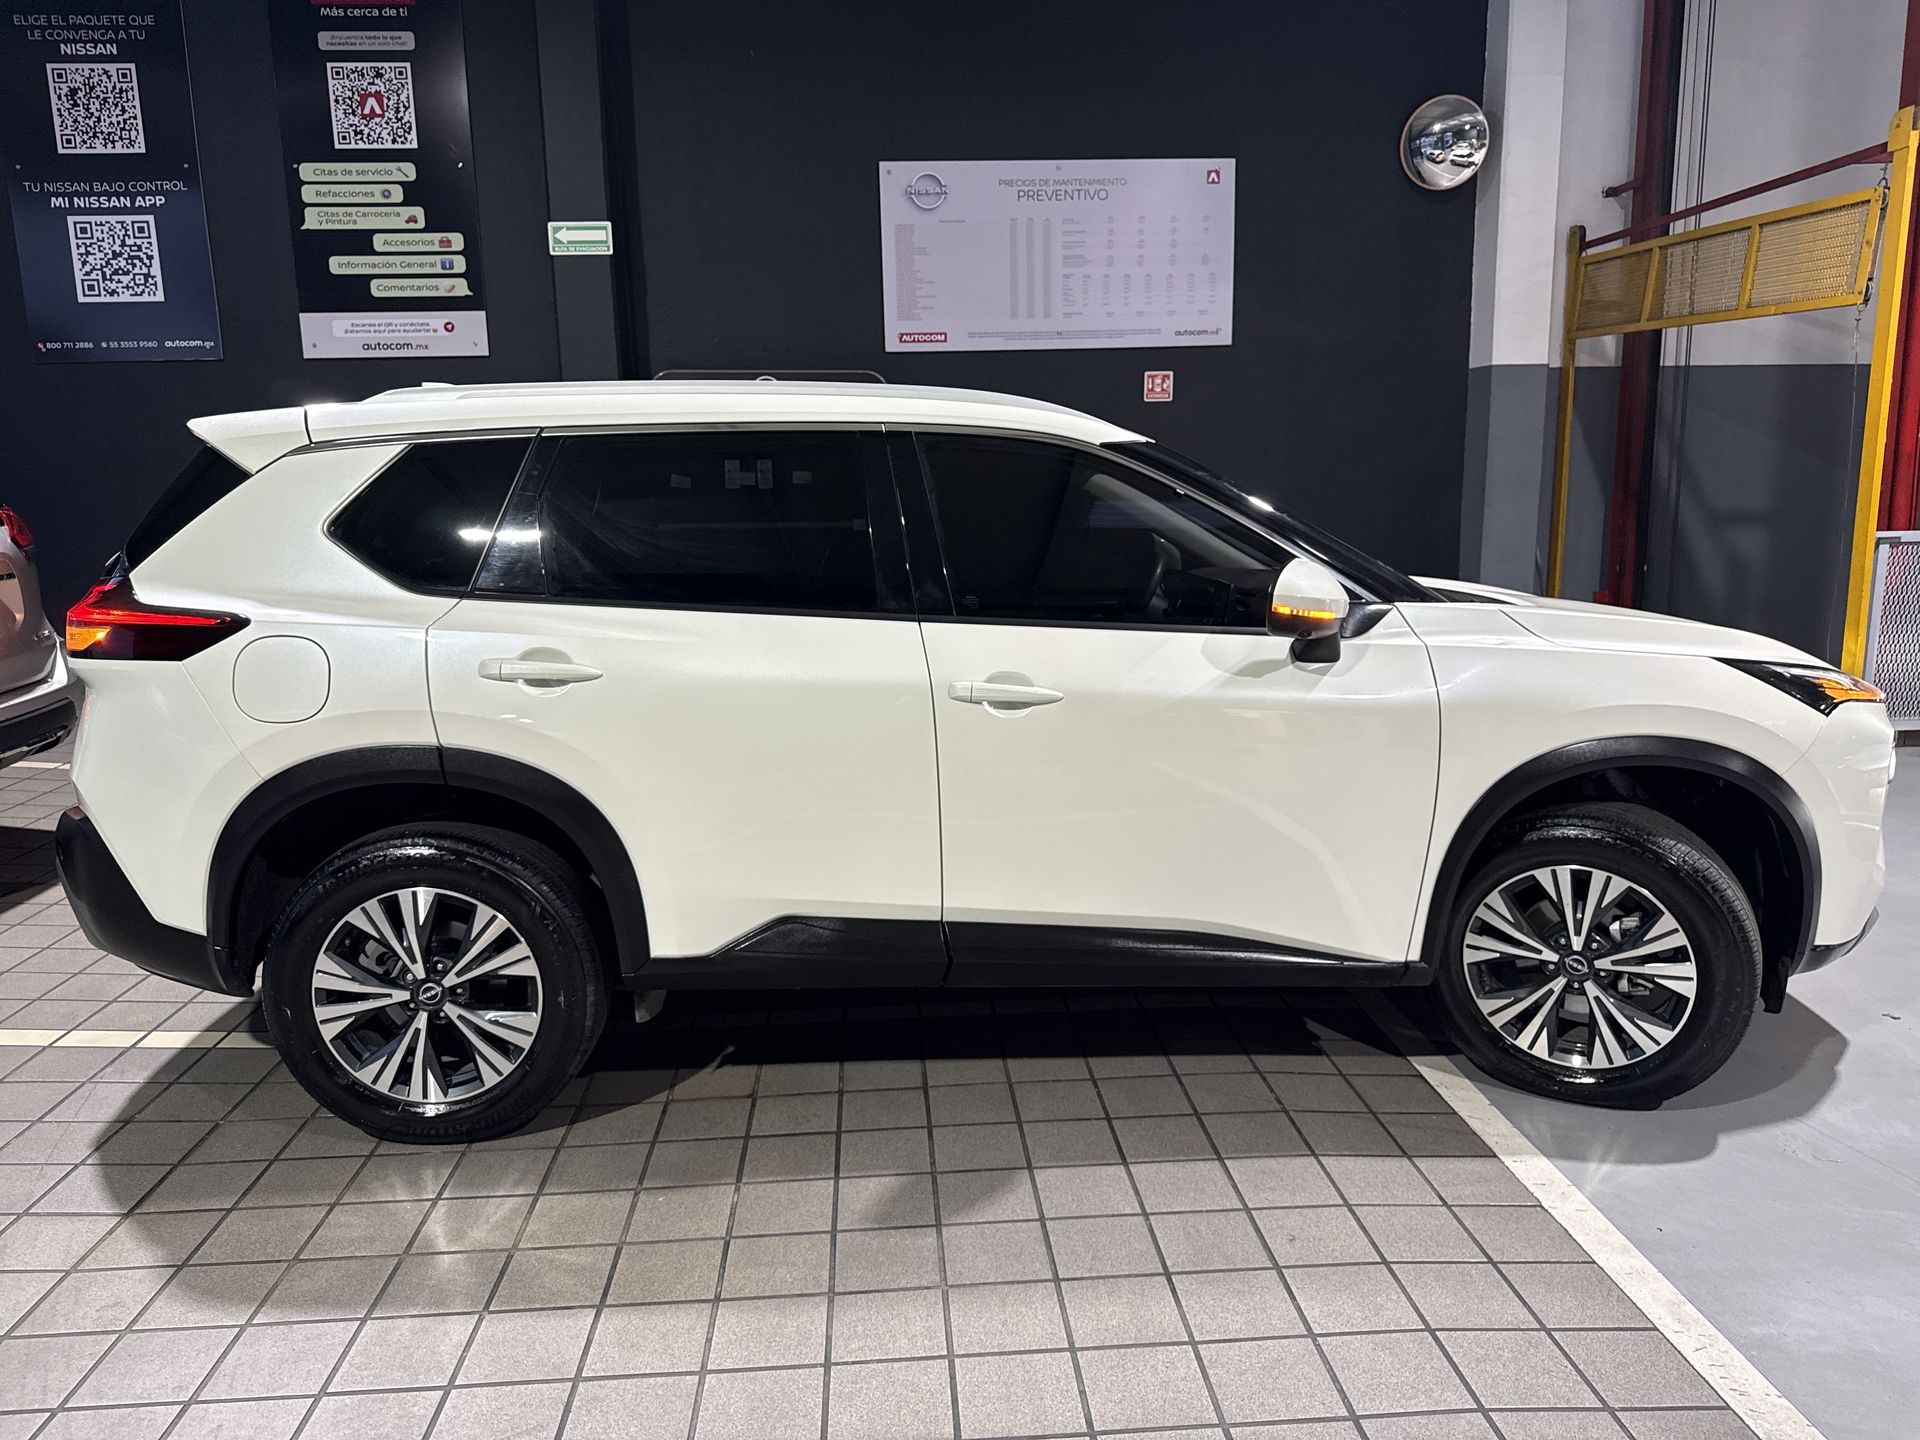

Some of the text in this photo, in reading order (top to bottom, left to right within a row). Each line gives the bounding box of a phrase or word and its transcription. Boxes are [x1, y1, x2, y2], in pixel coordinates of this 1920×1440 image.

[320, 6, 408, 17] Más cerca de ti
[13, 15, 155, 26] ELIGE EL PAQUETE QUE
[27, 30, 146, 40] LE CONVENGA A TU
[60, 43, 118, 55] NISSAN
[313, 168, 393, 177] Citas de servicio
[23, 181, 188, 192] TU NISSAN BAJO CONTROL
[998, 178, 1127, 188] PRECIOS DE MANTENIMIENTO
[315, 189, 375, 198] Refacciones
[905, 186, 948, 195] NISSAN
[1017, 189, 1109, 201] PREVENTIVO
[51, 196, 166, 208] MI NISSAN APP
[317, 210, 400, 218] Citas de Carrocería
[325, 218, 358, 226] Pintura
[382, 239, 436, 247] Accesorios
[338, 260, 437, 269] Información General
[376, 283, 440, 292] Comentarios
[902, 334, 945, 342] AUTOCOM
[362, 341, 429, 351] autocom.mx
